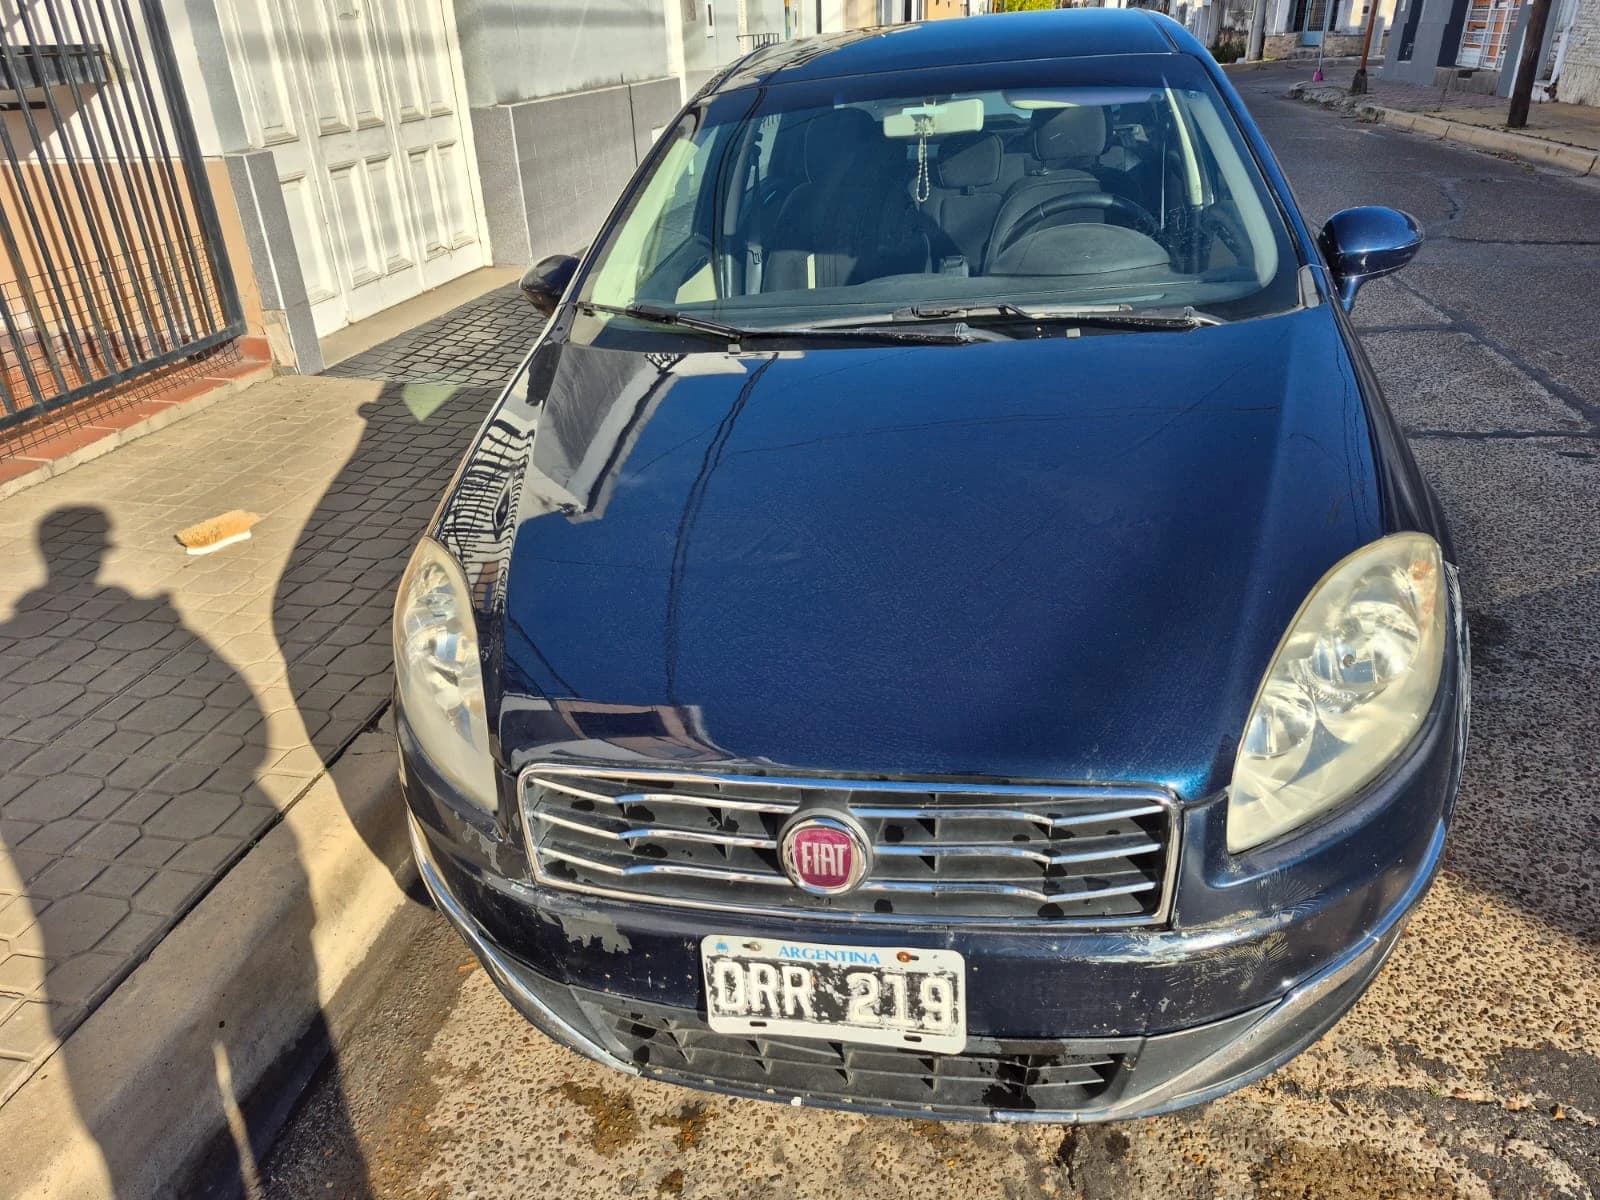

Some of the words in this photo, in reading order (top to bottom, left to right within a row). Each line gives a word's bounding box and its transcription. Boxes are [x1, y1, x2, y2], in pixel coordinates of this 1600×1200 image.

[801, 841, 848, 877] FIAT
[778, 946, 880, 964] ARGENTINA
[847, 972, 953, 1030] 219
